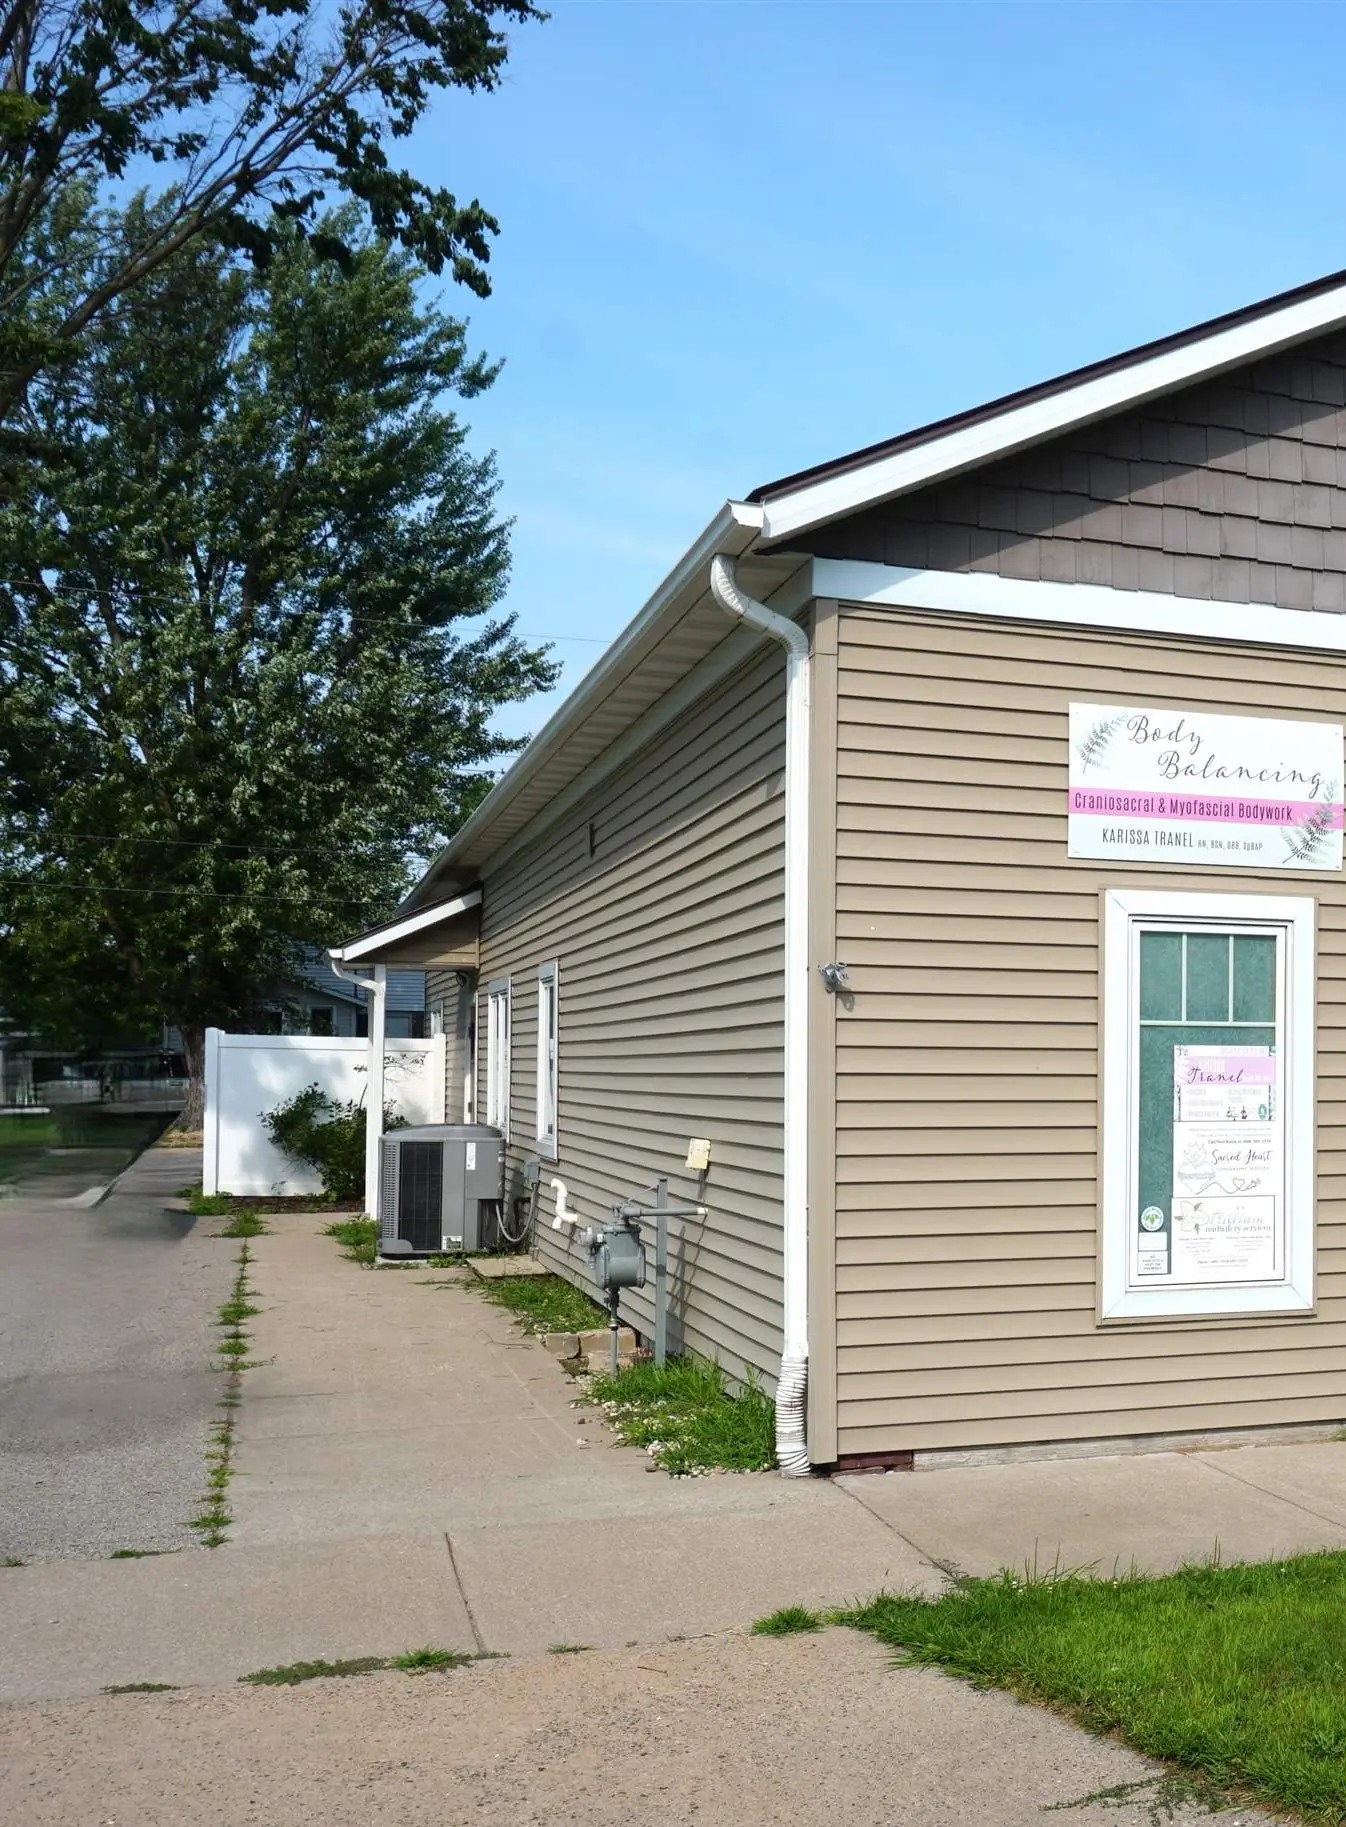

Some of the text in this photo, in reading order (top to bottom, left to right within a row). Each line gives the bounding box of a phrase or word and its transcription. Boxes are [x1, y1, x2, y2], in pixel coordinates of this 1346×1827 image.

[1126, 714, 1204, 755] Body
[1157, 749, 1325, 799] Balancing
[1075, 792, 1293, 822] Craniosacral & Myofascial Bodywork
[1102, 828, 1150, 846] KARISSA
[1154, 830, 1193, 848] TRANEL
[1187, 1064, 1244, 1084] Tranel
